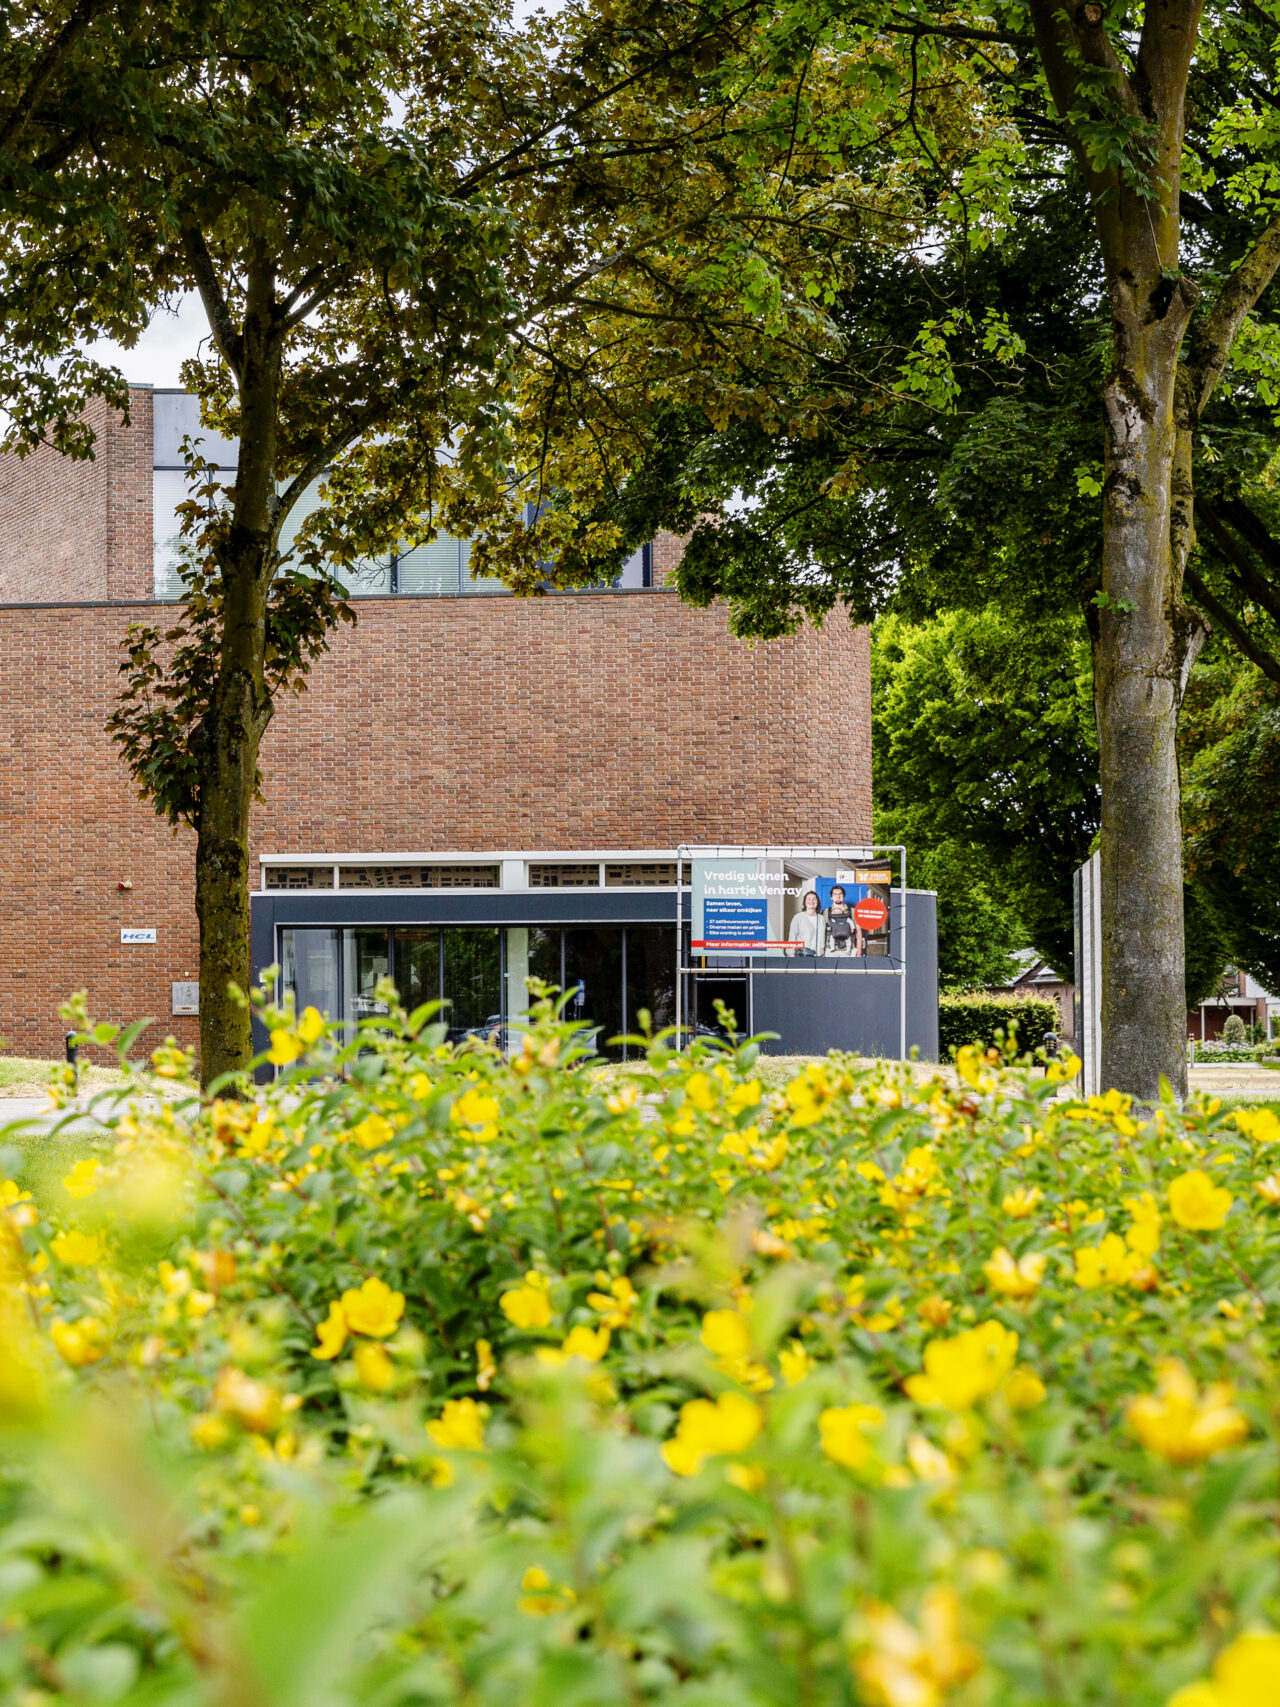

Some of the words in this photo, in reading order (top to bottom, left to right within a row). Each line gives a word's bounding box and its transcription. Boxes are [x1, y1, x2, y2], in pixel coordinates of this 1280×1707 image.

[703, 870, 745, 883] Vredig
[747, 872, 789, 881] wonen
[703, 884, 716, 895] in
[718, 884, 756, 896] hartje
[758, 886, 802, 897] Venray
